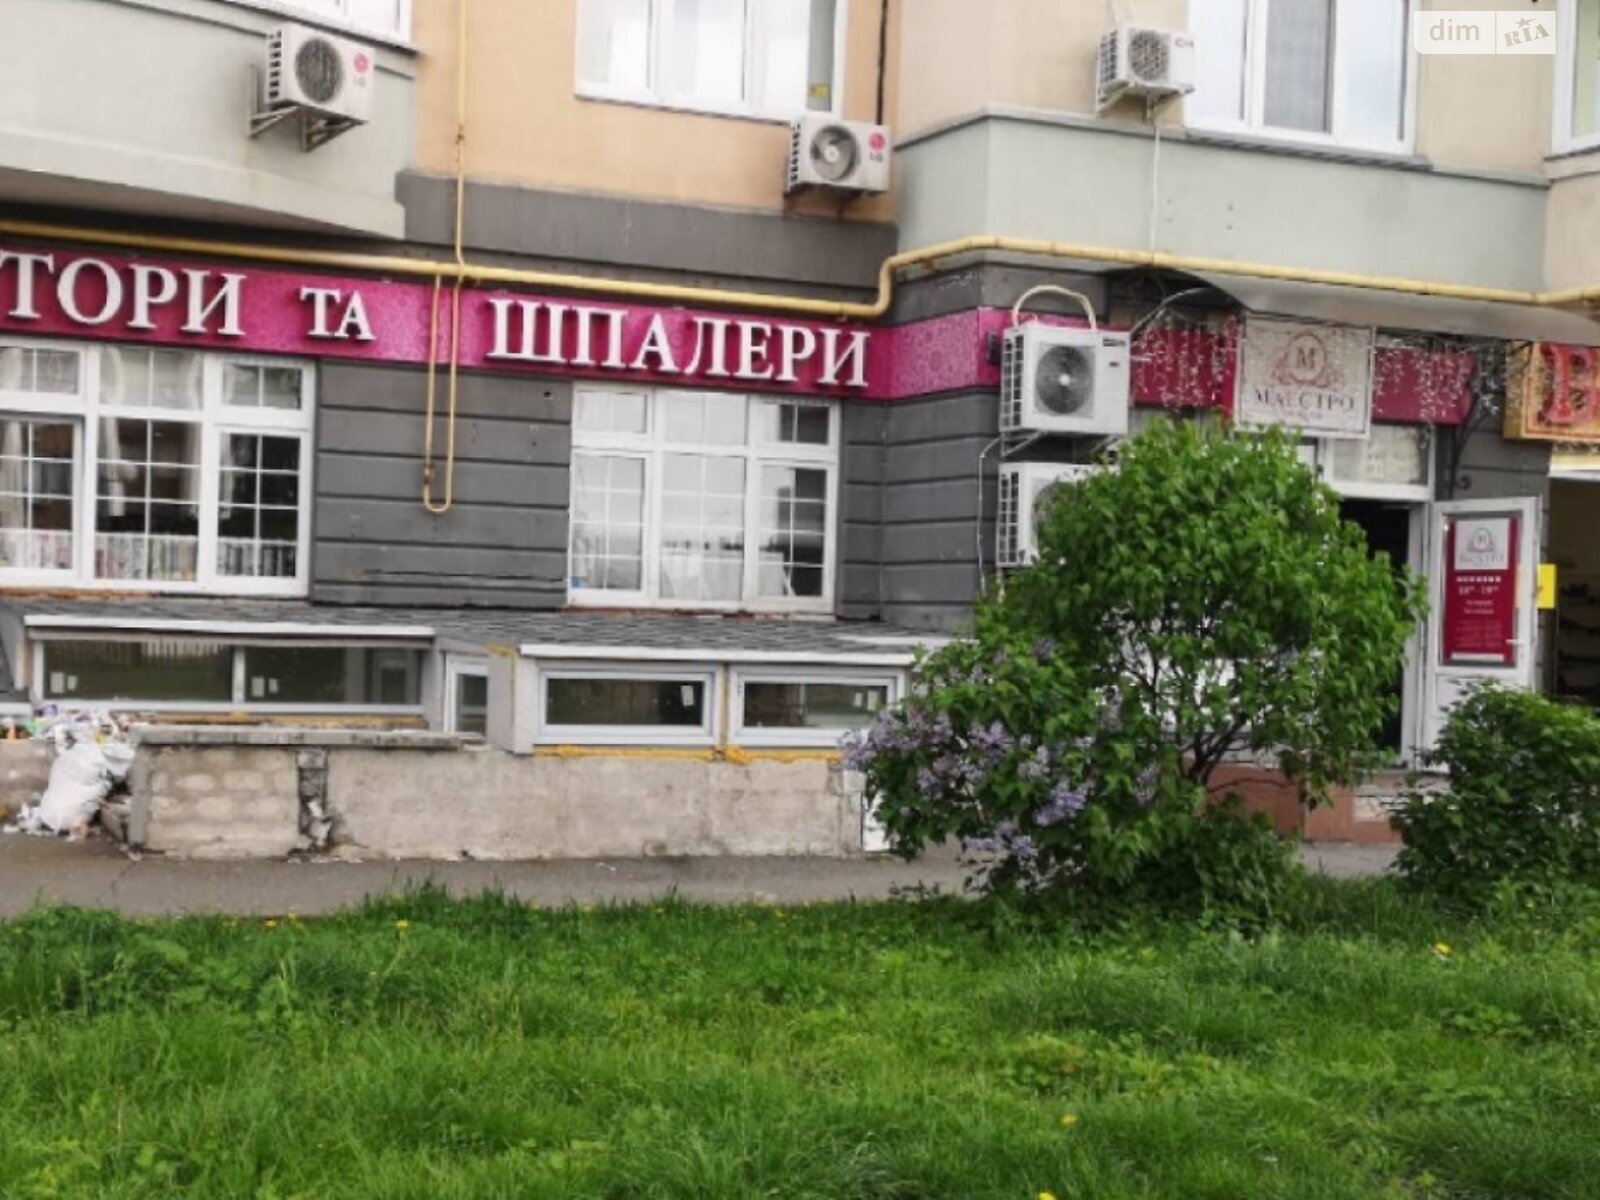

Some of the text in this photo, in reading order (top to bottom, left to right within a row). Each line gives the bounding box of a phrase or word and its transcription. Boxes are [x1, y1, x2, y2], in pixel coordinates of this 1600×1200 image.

[0, 249, 870, 388] ТОРИ ТА ШПАЛЕРИ
